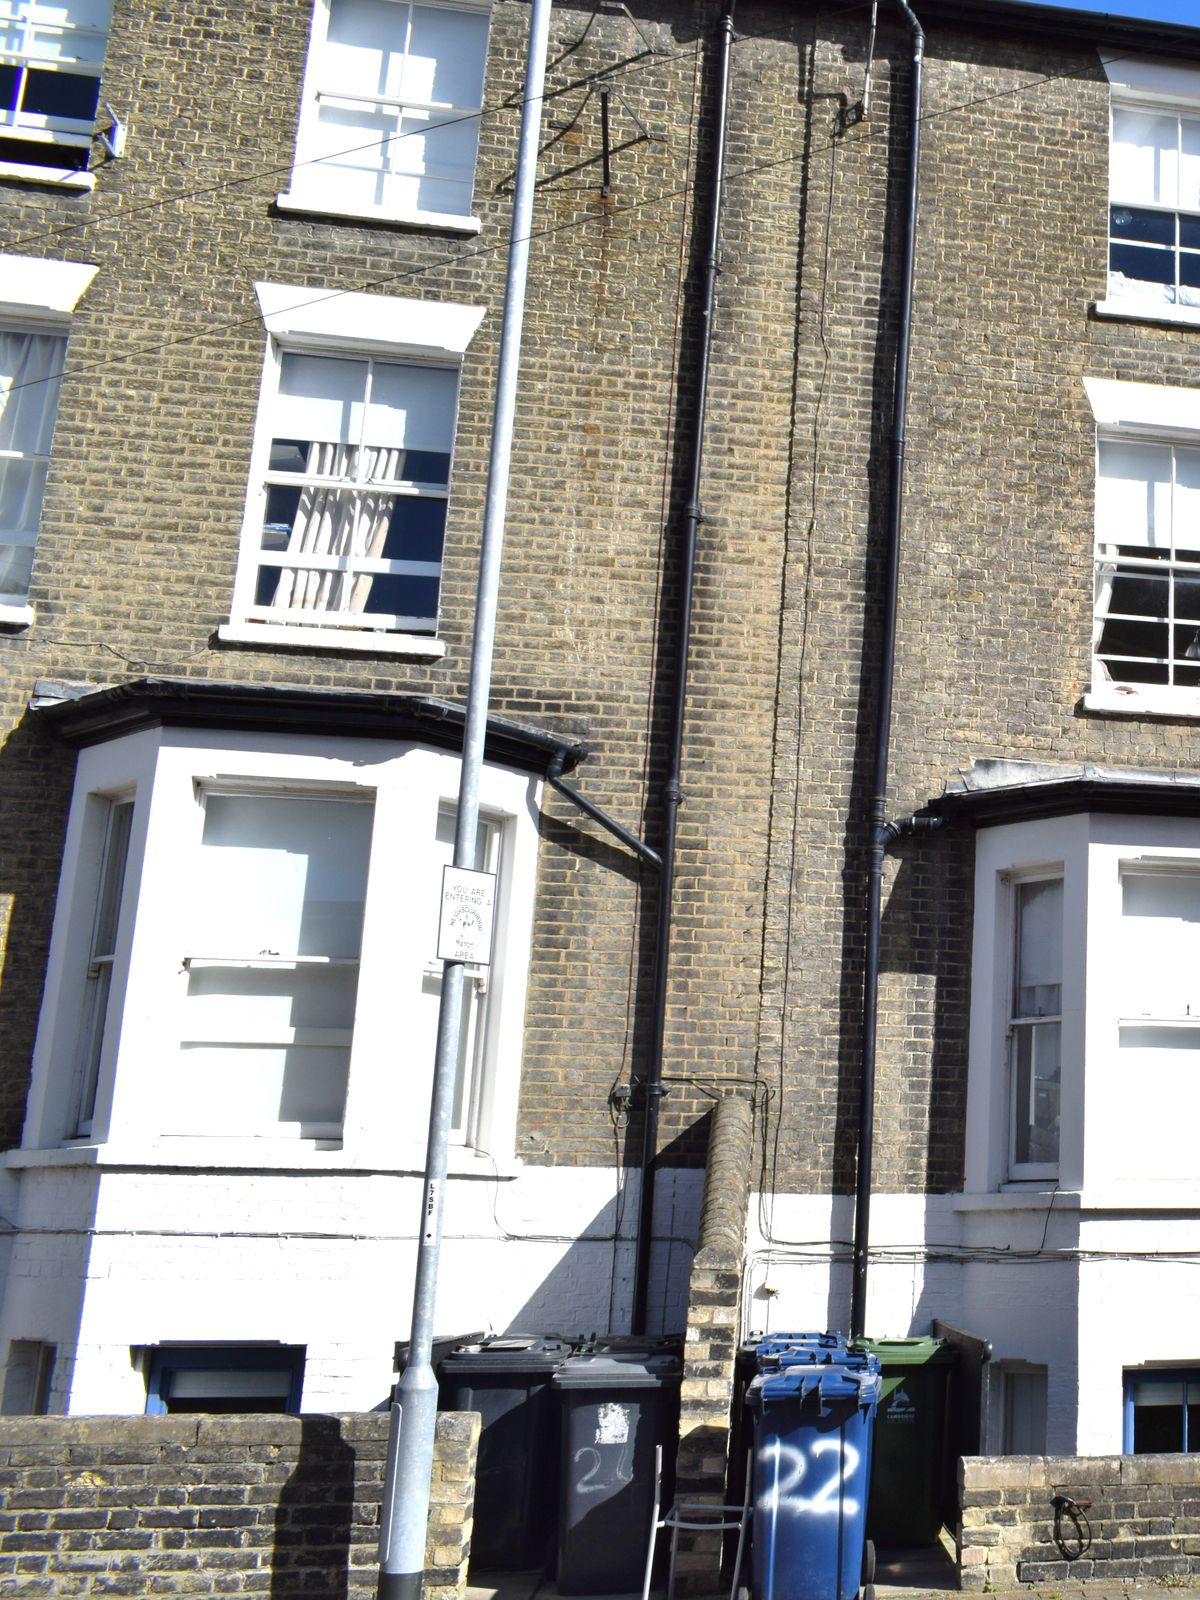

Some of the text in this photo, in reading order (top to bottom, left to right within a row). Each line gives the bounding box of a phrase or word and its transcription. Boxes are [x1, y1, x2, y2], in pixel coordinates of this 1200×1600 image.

[453, 885, 485, 897] YOU ARE
[445, 892, 482, 905] ENTERING
[454, 950, 475, 960] AREA
[757, 1438, 859, 1515] 22
